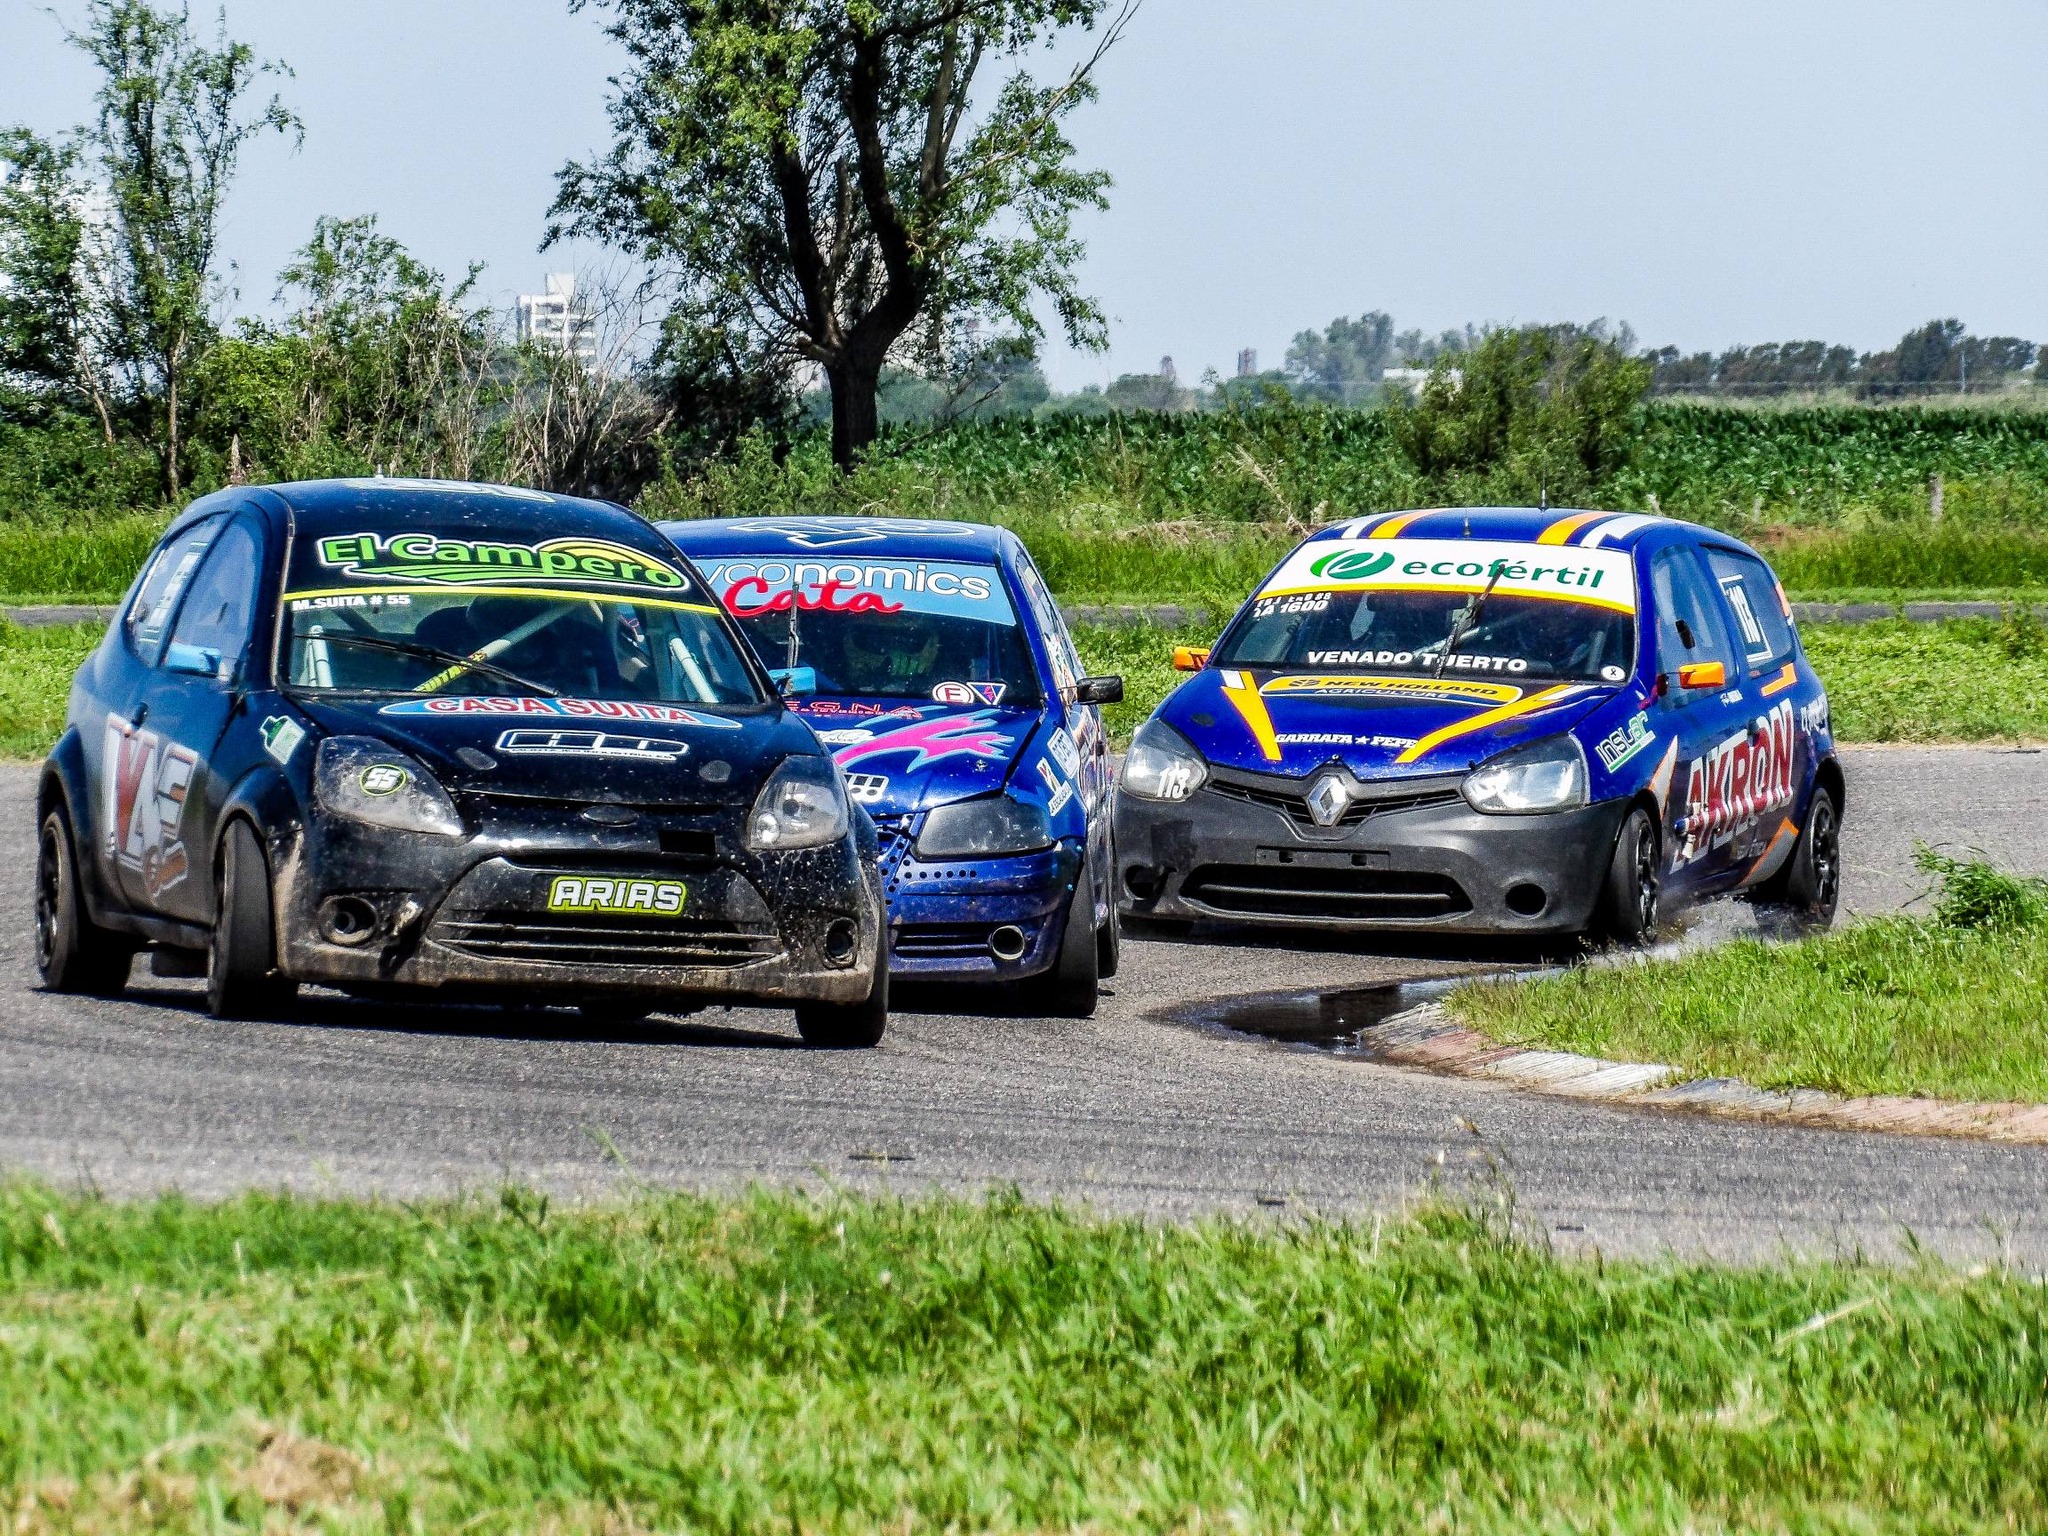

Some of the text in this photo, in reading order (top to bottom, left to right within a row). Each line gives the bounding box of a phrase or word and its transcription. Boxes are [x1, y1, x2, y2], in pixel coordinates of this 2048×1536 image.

[323, 535, 683, 589] El Campero
[1401, 558, 1605, 588] ecofértil
[291, 595, 367, 611] M.SUITA
[386, 594, 411, 605] 55
[722, 576, 904, 617] Cata
[1280, 600, 1329, 613] 1600
[1308, 651, 1413, 664] VENADO
[1313, 688, 1449, 699] AGRICULTURE
[1325, 680, 1498, 695] NEW HOLLAND
[424, 696, 700, 724] CASA SUITA
[1275, 733, 1419, 749] GARRAFA PEPE
[364, 767, 399, 789] 55
[1682, 699, 1796, 838] AKRON
[552, 878, 683, 913] ARIAS
